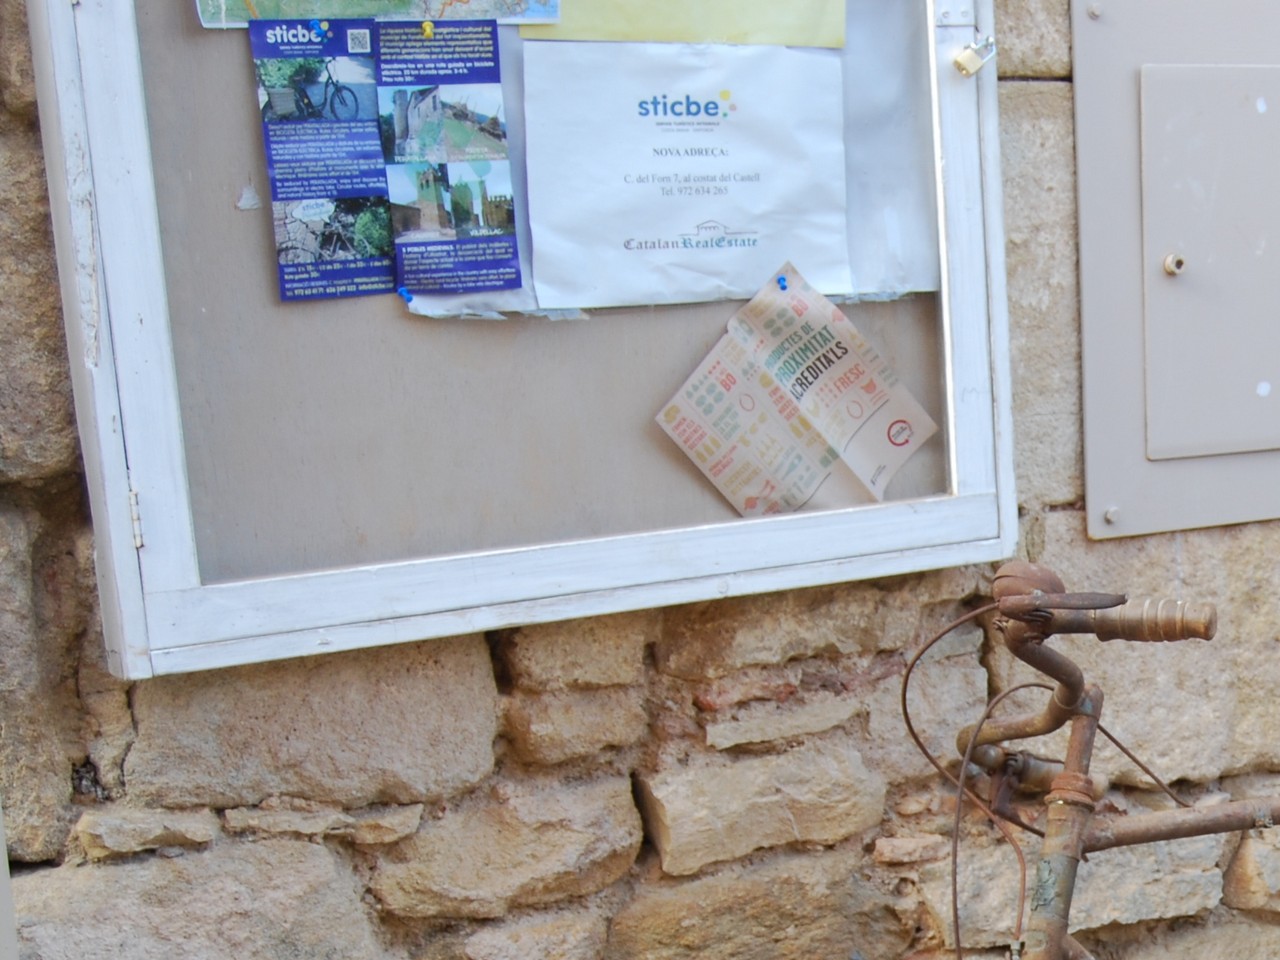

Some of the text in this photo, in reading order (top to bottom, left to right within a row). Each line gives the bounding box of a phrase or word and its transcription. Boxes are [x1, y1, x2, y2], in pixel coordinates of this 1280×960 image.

[266, 25, 321, 43] sticbe
[638, 94, 719, 116] sticbe
[652, 147, 729, 158] NOVA ADREÇA:
[623, 174, 634, 184] C.
[636, 174, 649, 183] del
[651, 174, 670, 183] Forn
[683, 173, 691, 183] al
[693, 174, 717, 183] costat
[719, 173, 731, 182] del
[733, 172, 760, 182] Castell
[677, 186, 692, 196] 972
[695, 186, 711, 195] 634
[764, 321, 815, 370] PRODUCTES DE
[774, 324, 836, 387] PROXIMITAT
[833, 362, 865, 394] FRESC
